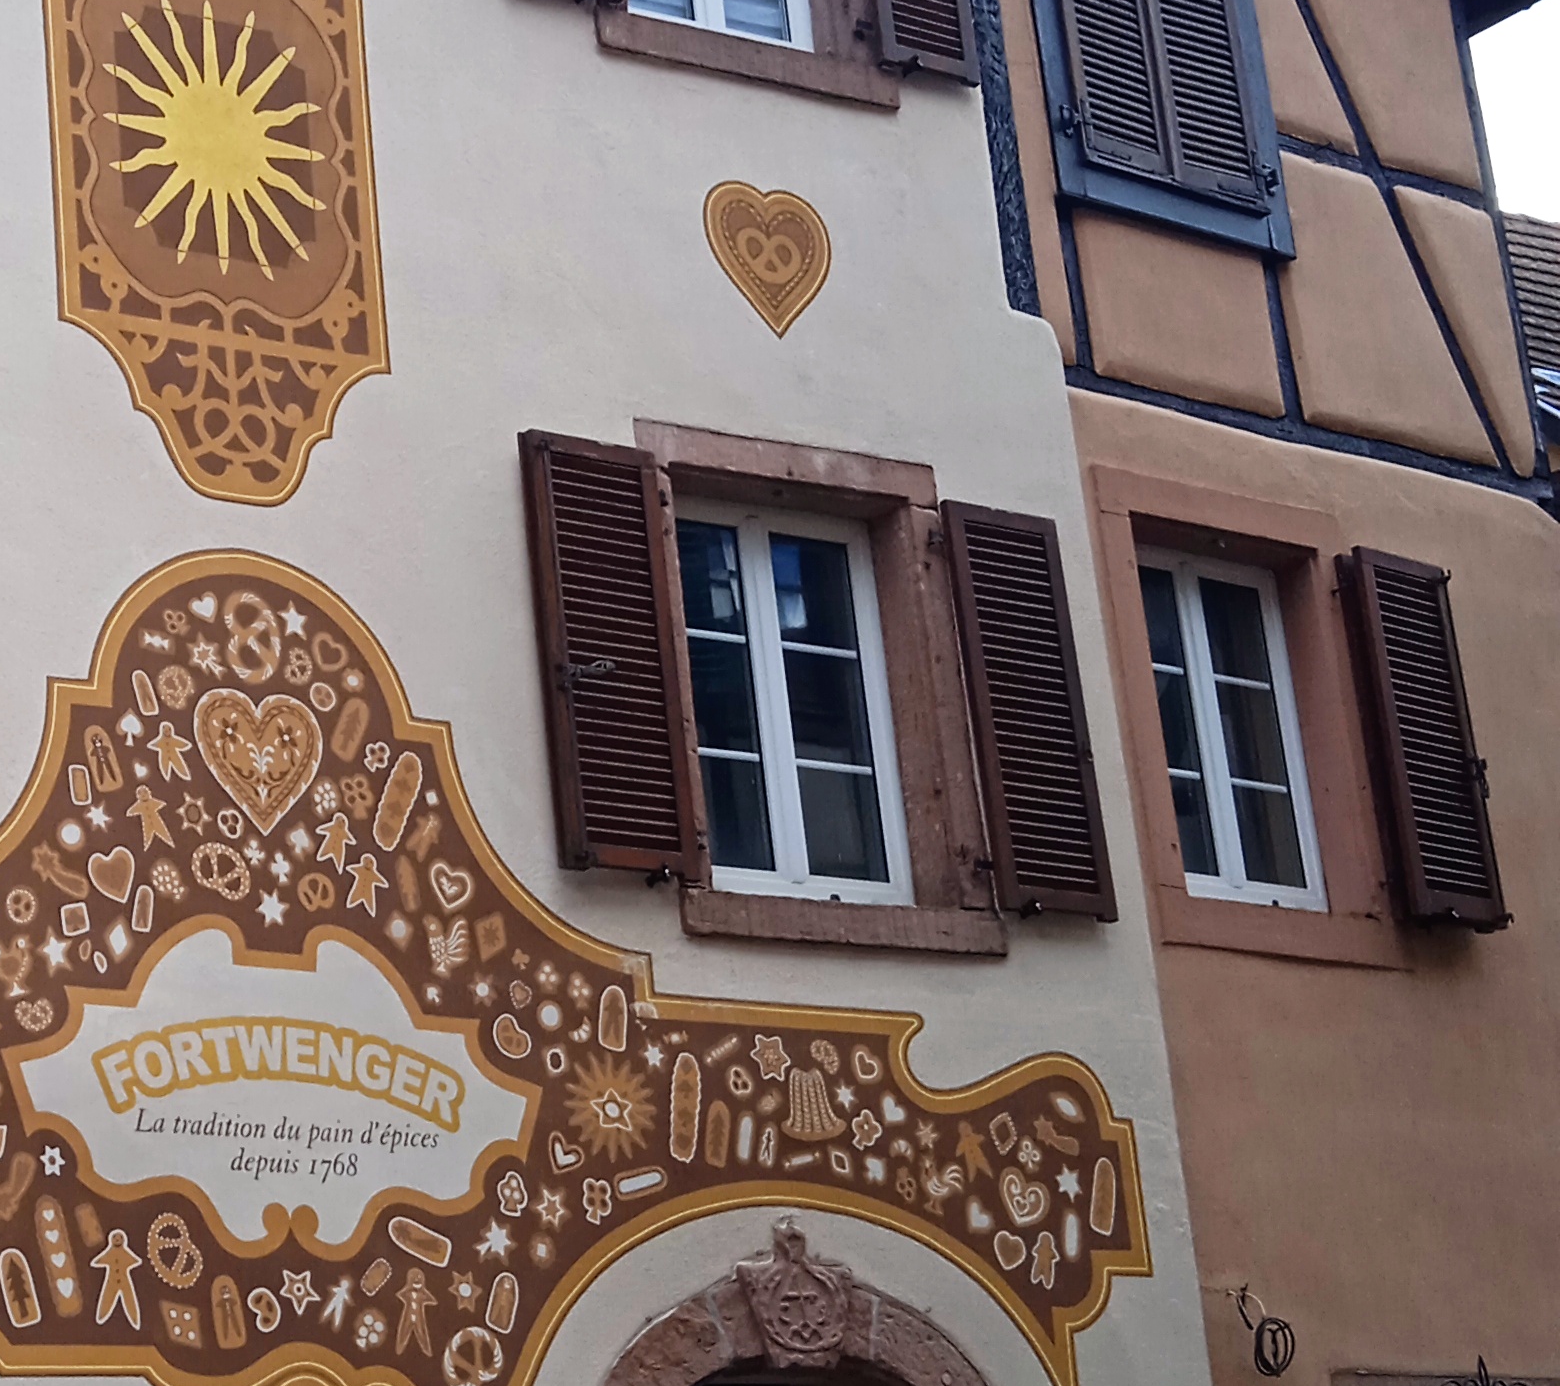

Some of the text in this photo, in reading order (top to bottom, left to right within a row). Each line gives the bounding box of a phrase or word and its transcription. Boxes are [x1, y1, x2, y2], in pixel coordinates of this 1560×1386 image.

[94, 1018, 463, 1129] FORTWENGER
[135, 1108, 439, 1149] La tradition du pain d'épices
[230, 1147, 359, 1183] depuis 1768
